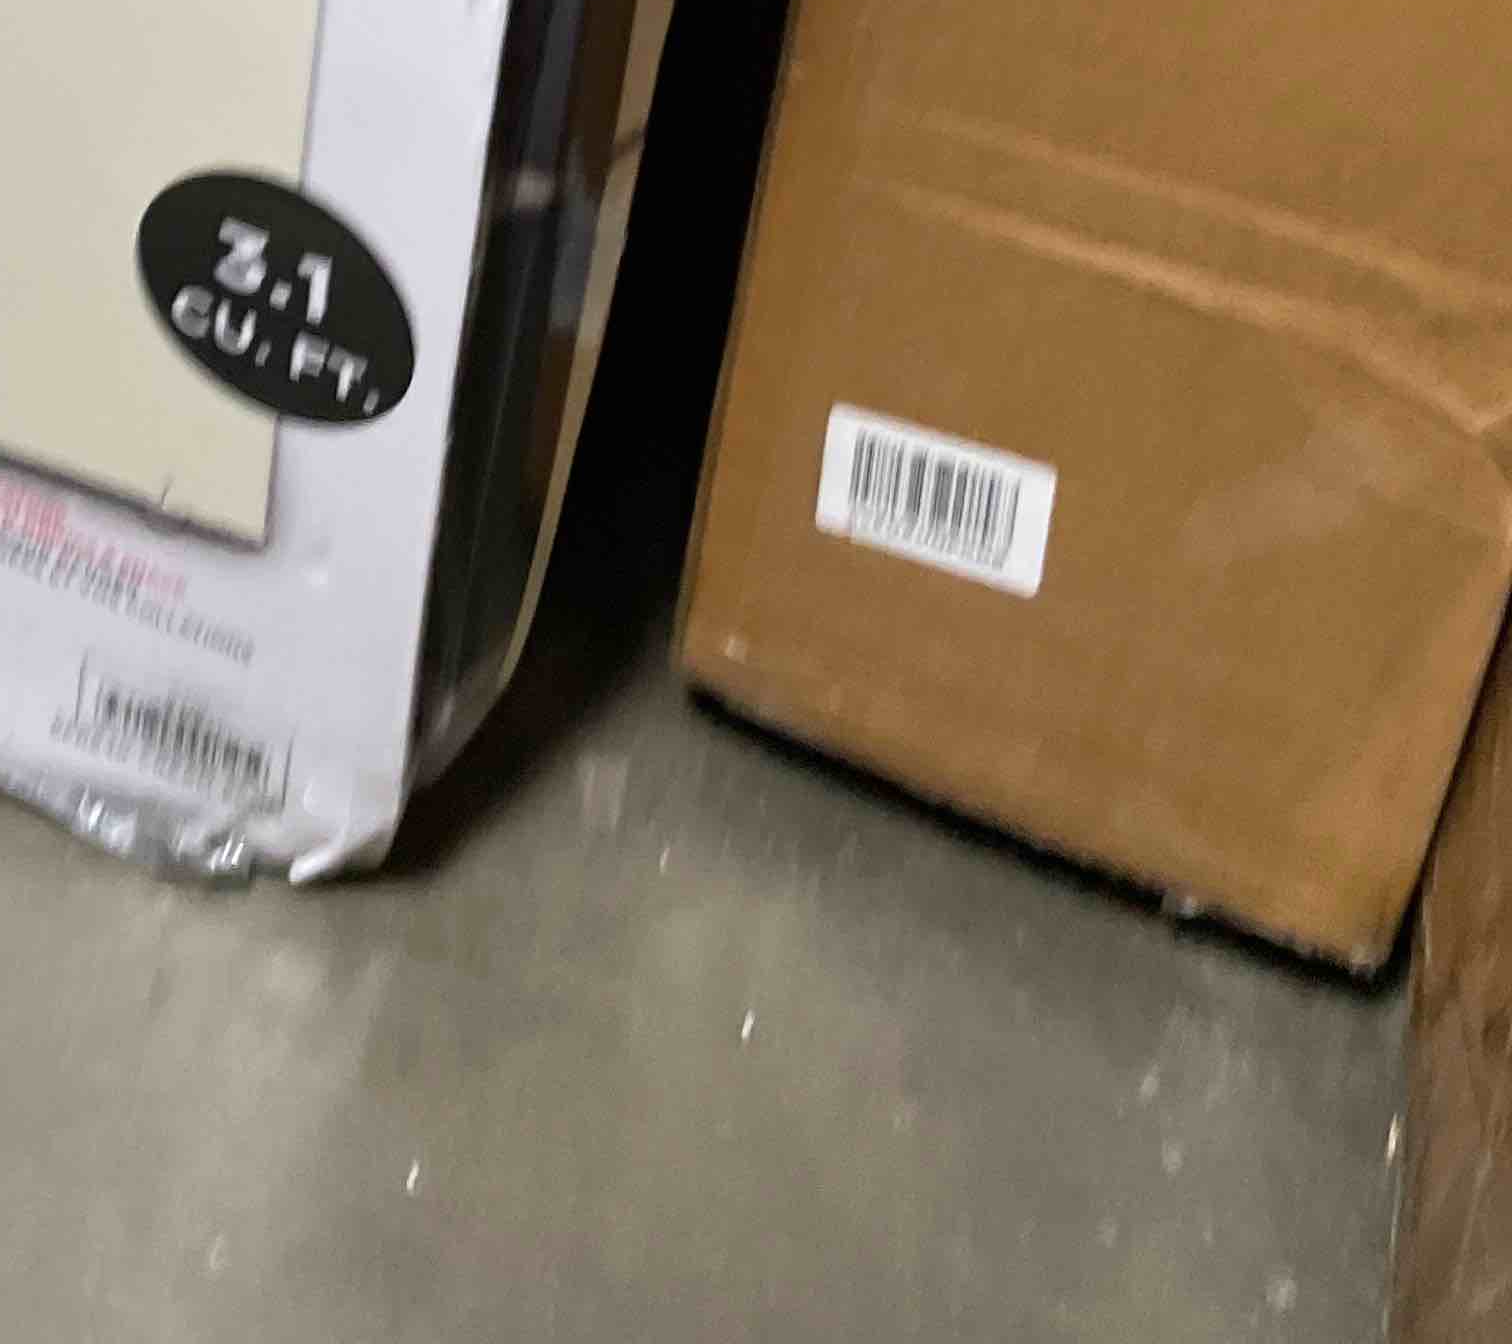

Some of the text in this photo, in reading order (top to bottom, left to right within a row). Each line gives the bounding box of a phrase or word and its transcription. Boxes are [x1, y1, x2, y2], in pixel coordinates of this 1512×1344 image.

[213, 215, 333, 326] 3.1
[171, 284, 380, 416] CU. FT.
